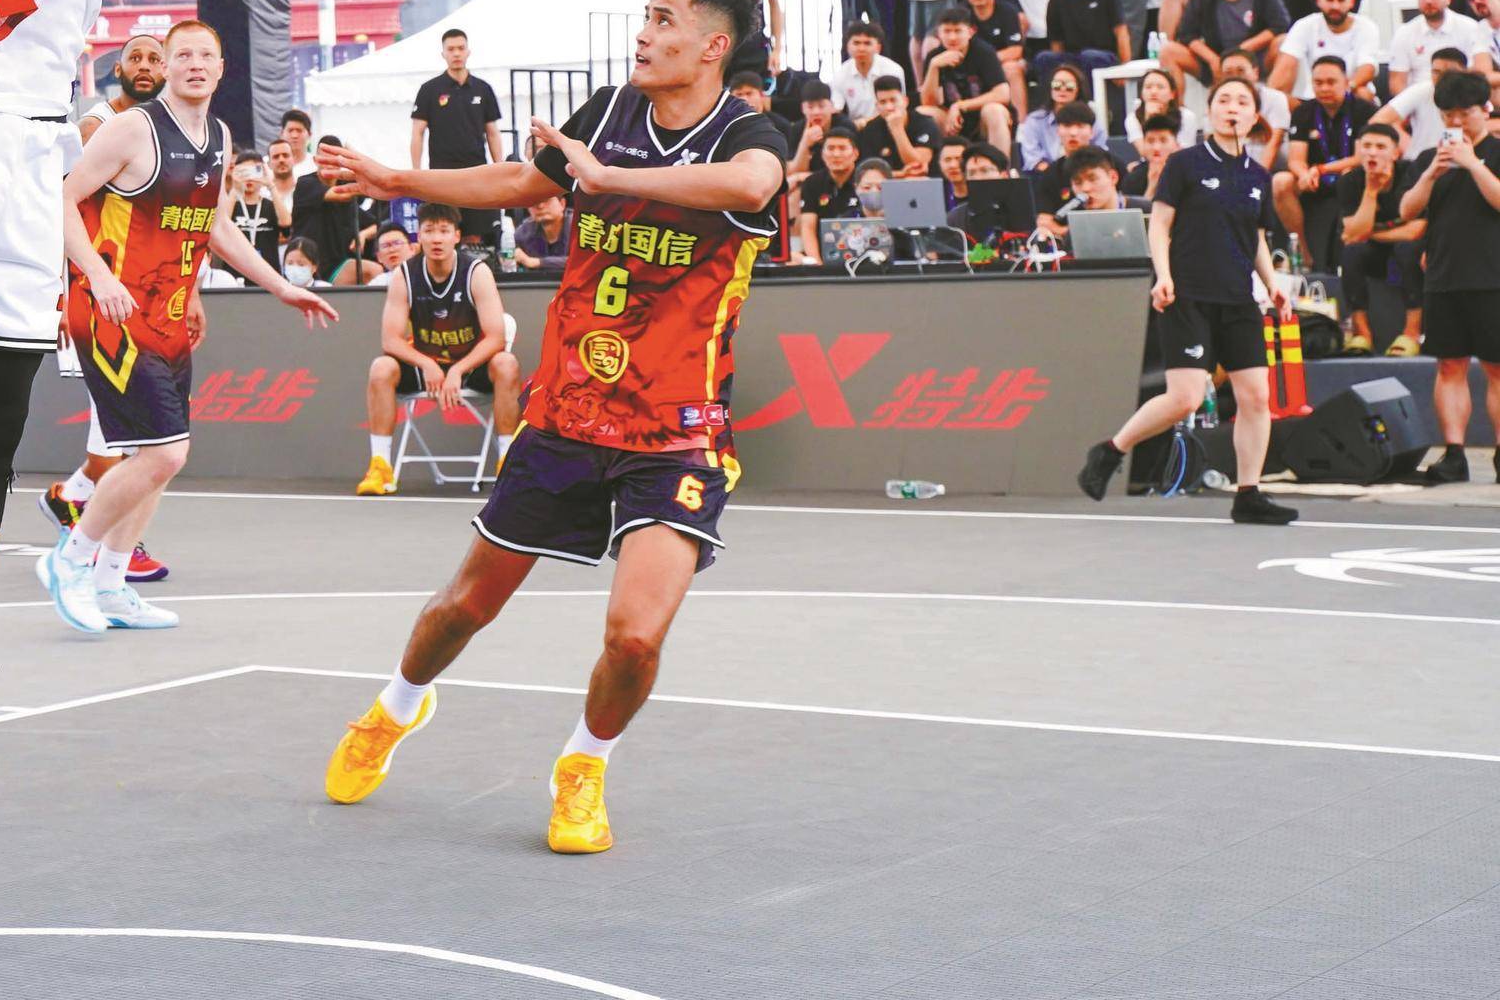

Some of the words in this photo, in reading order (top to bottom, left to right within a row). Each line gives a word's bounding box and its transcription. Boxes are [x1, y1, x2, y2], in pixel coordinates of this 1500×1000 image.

[593, 264, 630, 317] 6
[861, 366, 1054, 431] 特步
[673, 473, 707, 512] 6
